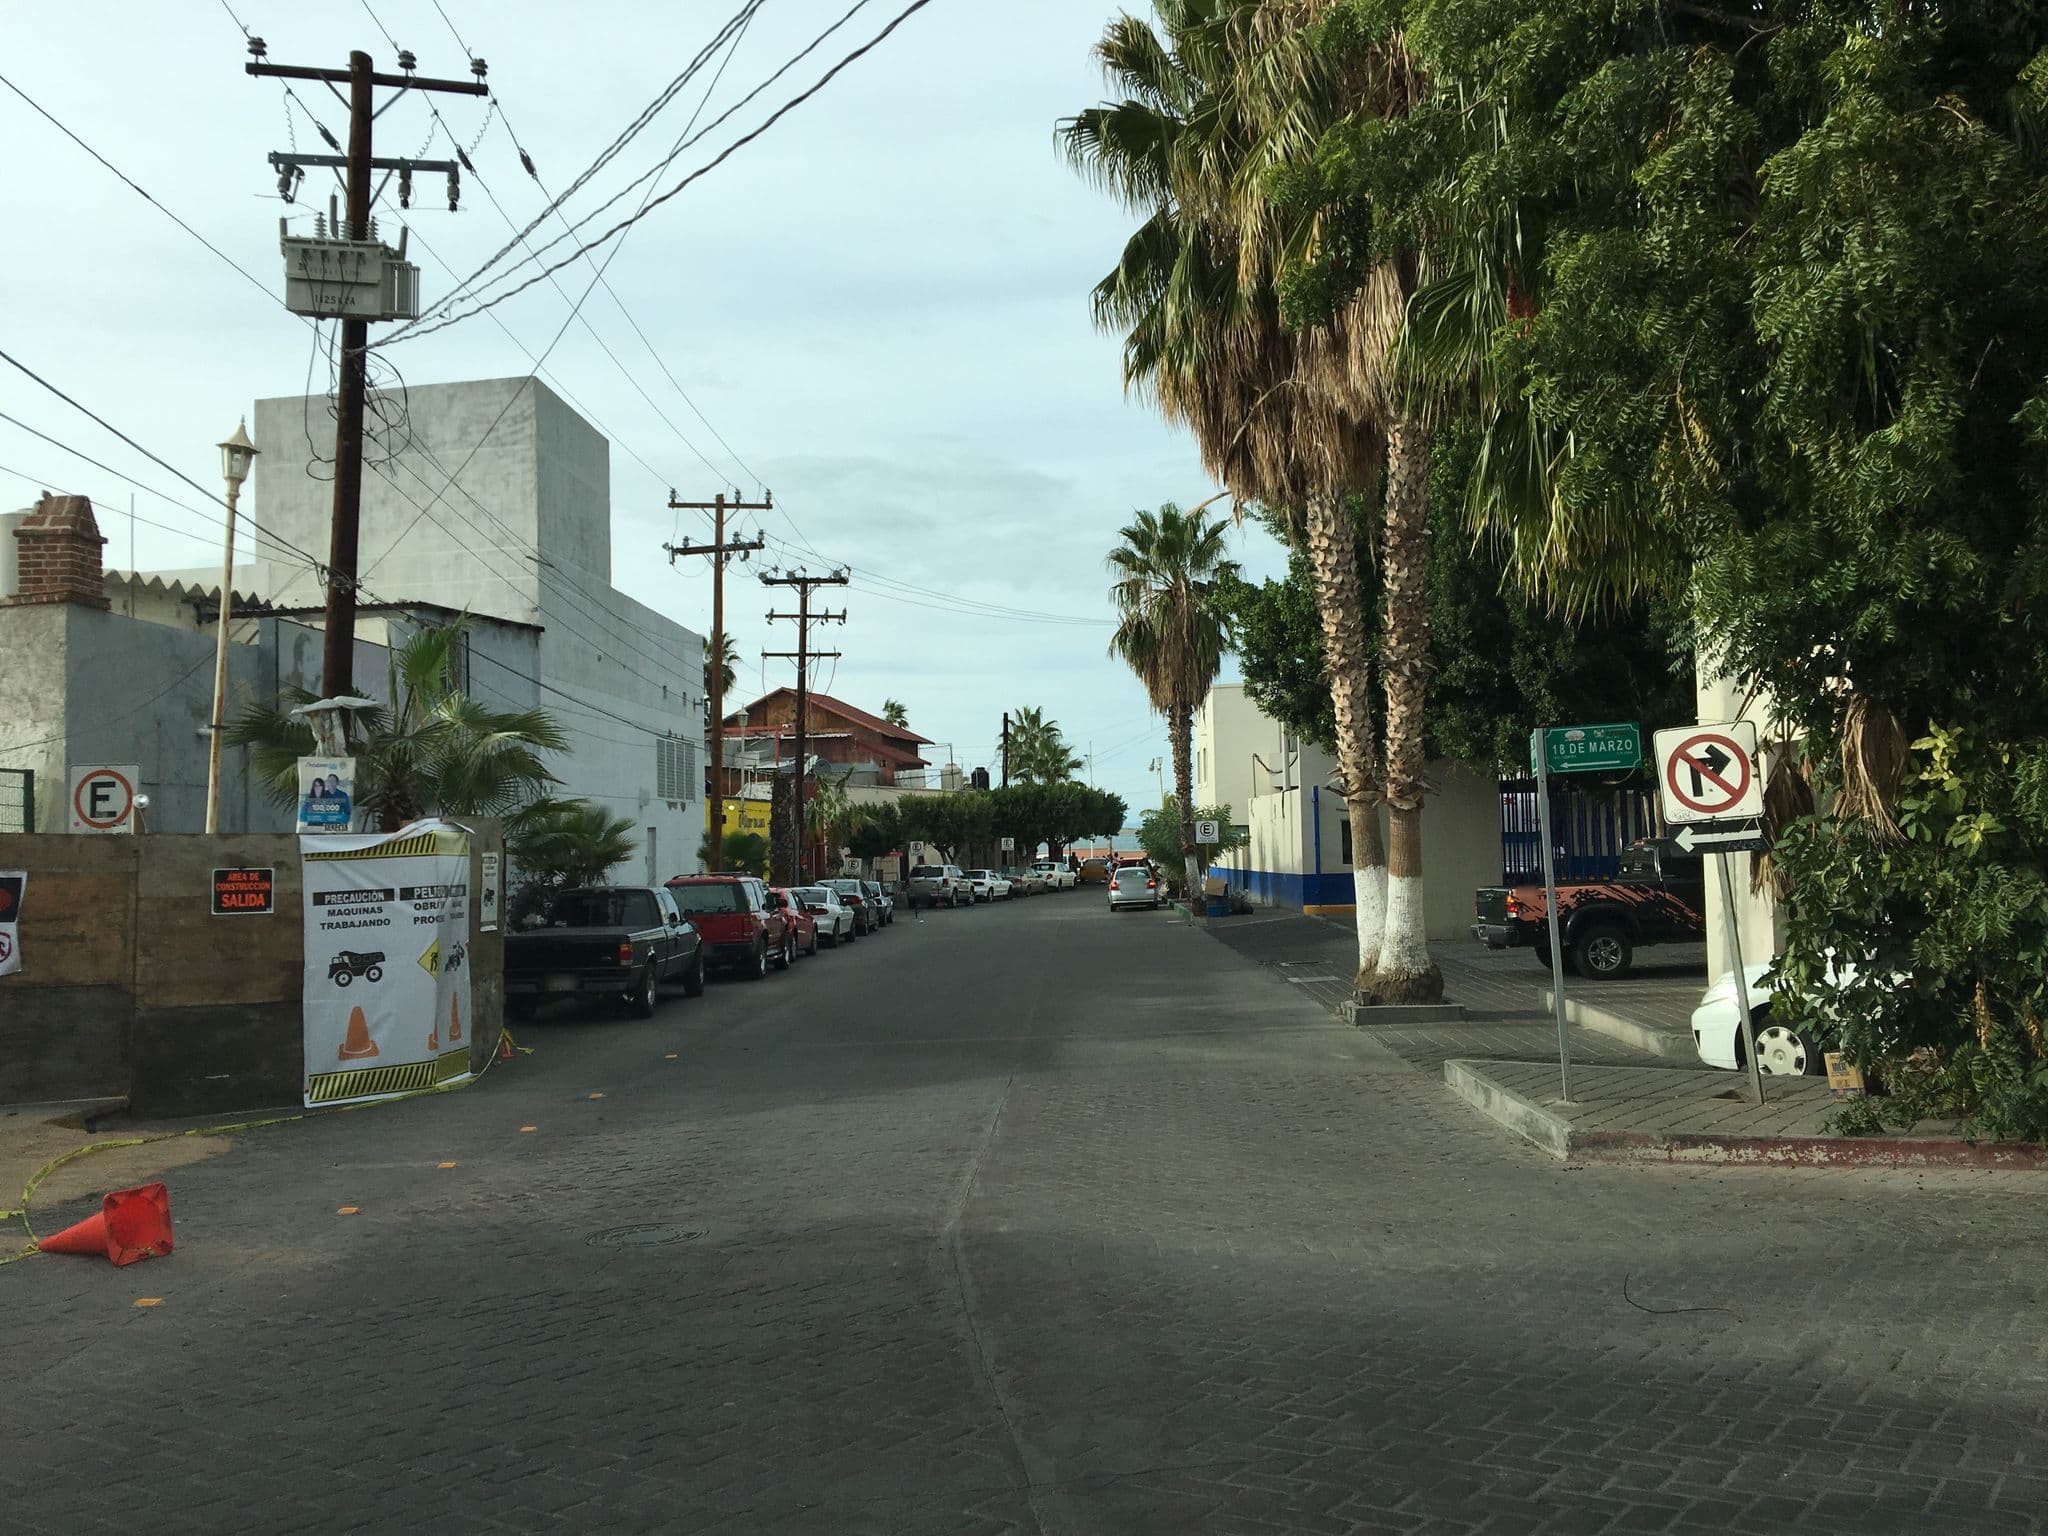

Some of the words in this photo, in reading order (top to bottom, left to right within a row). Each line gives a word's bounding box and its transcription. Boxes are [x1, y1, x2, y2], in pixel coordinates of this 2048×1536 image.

[1552, 744, 1566, 755] 18
[1569, 742, 1585, 754] DE
[1589, 739, 1633, 753] MARZO
[90, 781, 117, 818] E
[249, 872, 259, 880] DE
[221, 893, 265, 908] SALIDA
[327, 906, 383, 918] MAQUINAS
[319, 918, 391, 931] TRABAJANDO
